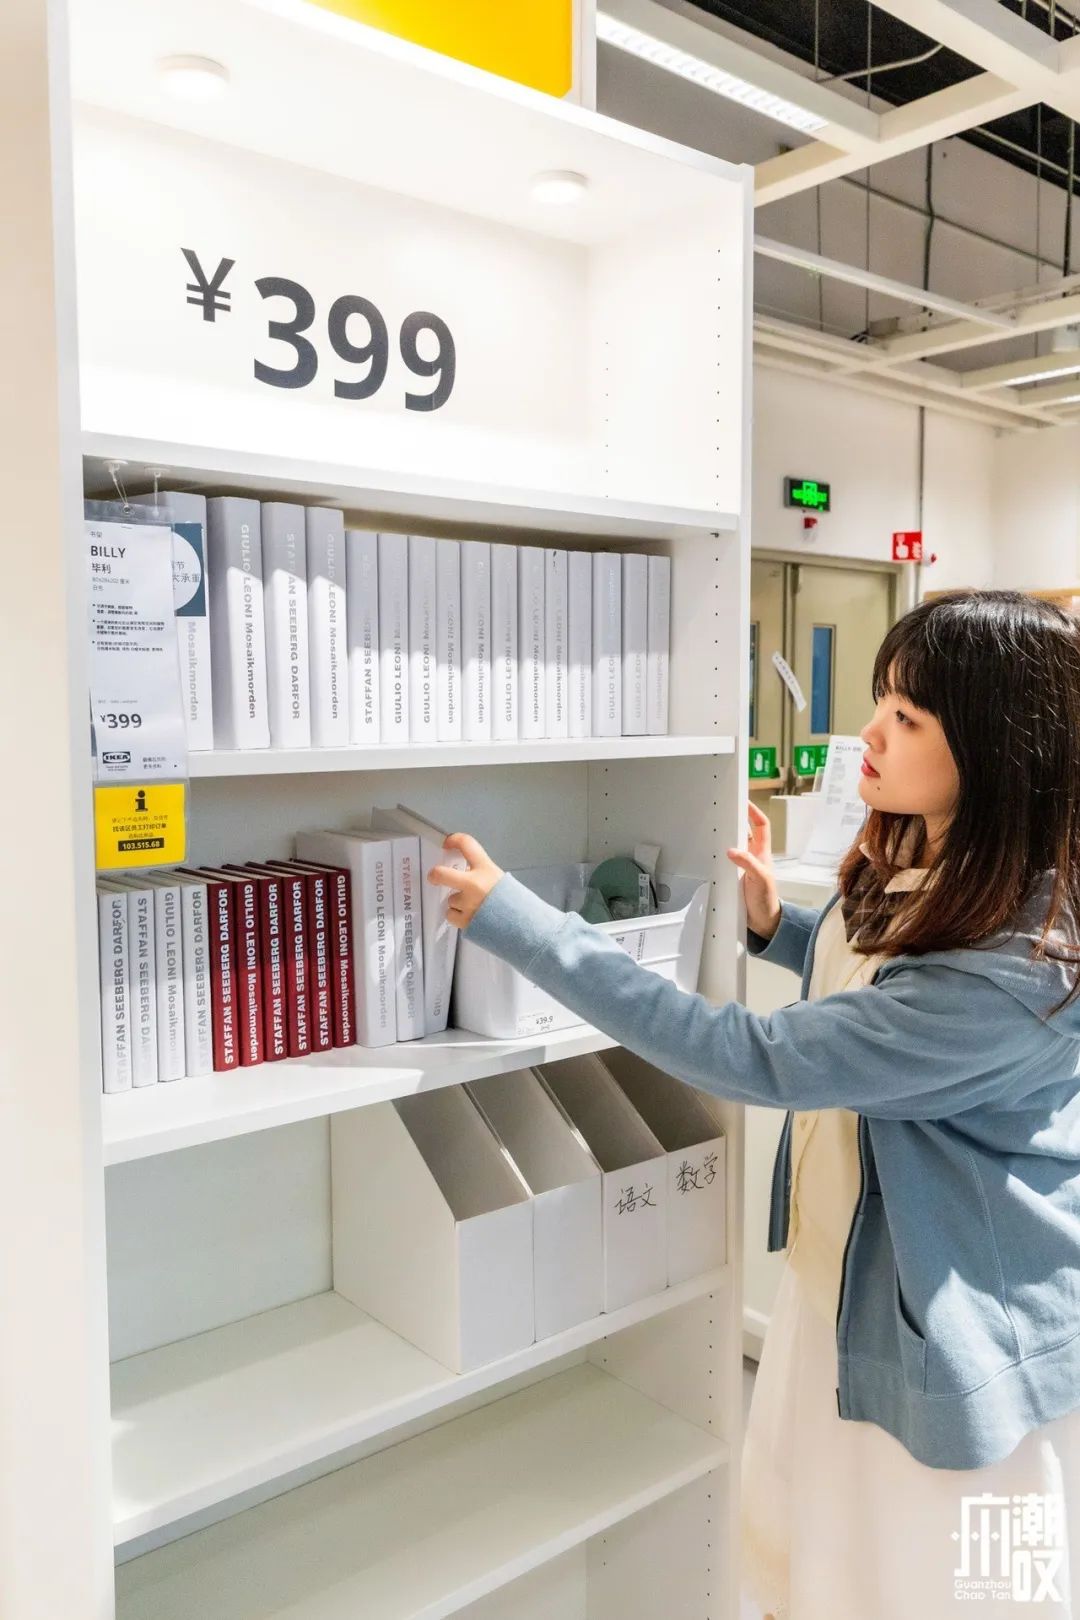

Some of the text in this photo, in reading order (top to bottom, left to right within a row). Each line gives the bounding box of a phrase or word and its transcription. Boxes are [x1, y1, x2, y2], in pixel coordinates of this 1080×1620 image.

[180, 247, 456, 412] ¥399
[91, 545, 126, 558] BILLY
[92, 562, 111, 574] 毕利
[241, 524, 256, 719] GIULIO LEONI Mosaikmorden
[288, 599, 299, 661] SEEBERG
[326, 533, 338, 719] GIULIO LEONI Mosaikmorden
[394, 646, 402, 678] LEONI
[187, 621, 198, 721] Mosaikmorden
[290, 664, 301, 719] DARFOR
[363, 612, 373, 724] STAFFAN SEEBE
[394, 682, 402, 724] GIULIO
[423, 682, 431, 724] GIULIO
[100, 713, 142, 729] ¥399
[122, 841, 161, 850] 103.515.68
[112, 899, 124, 955] DARFOR
[191, 891, 204, 944] DARFOR
[375, 860, 387, 1029] GIULIO LEONI Mosaikmorden
[402, 856, 416, 1019] STAFFAN SEEBERG DARFOR
[114, 958, 125, 1020] SEEBERG
[137, 897, 151, 1073] STAFFAN SEEBERG DAR
[164, 892, 179, 1074] GIULIO LEONI Mosaikmor
[194, 945, 206, 1006] SEEBERG
[218, 888, 234, 1065] STAFFAN SEEBERG DARFOR
[244, 884, 258, 1061] GIULIO LEONI Mosaikmorden
[268, 883, 284, 1056] STAFFAN SEEBERG DARFOR
[292, 881, 307, 1051] STAFFAN SEEBERG DARFOR
[314, 879, 329, 1046] STAFFAN SEEBERG DARFOR
[337, 875, 350, 1043] GIULIO LEONI Mosaikmorden
[614, 1183, 657, 1215] 语文
[676, 1152, 719, 1195] 数学
